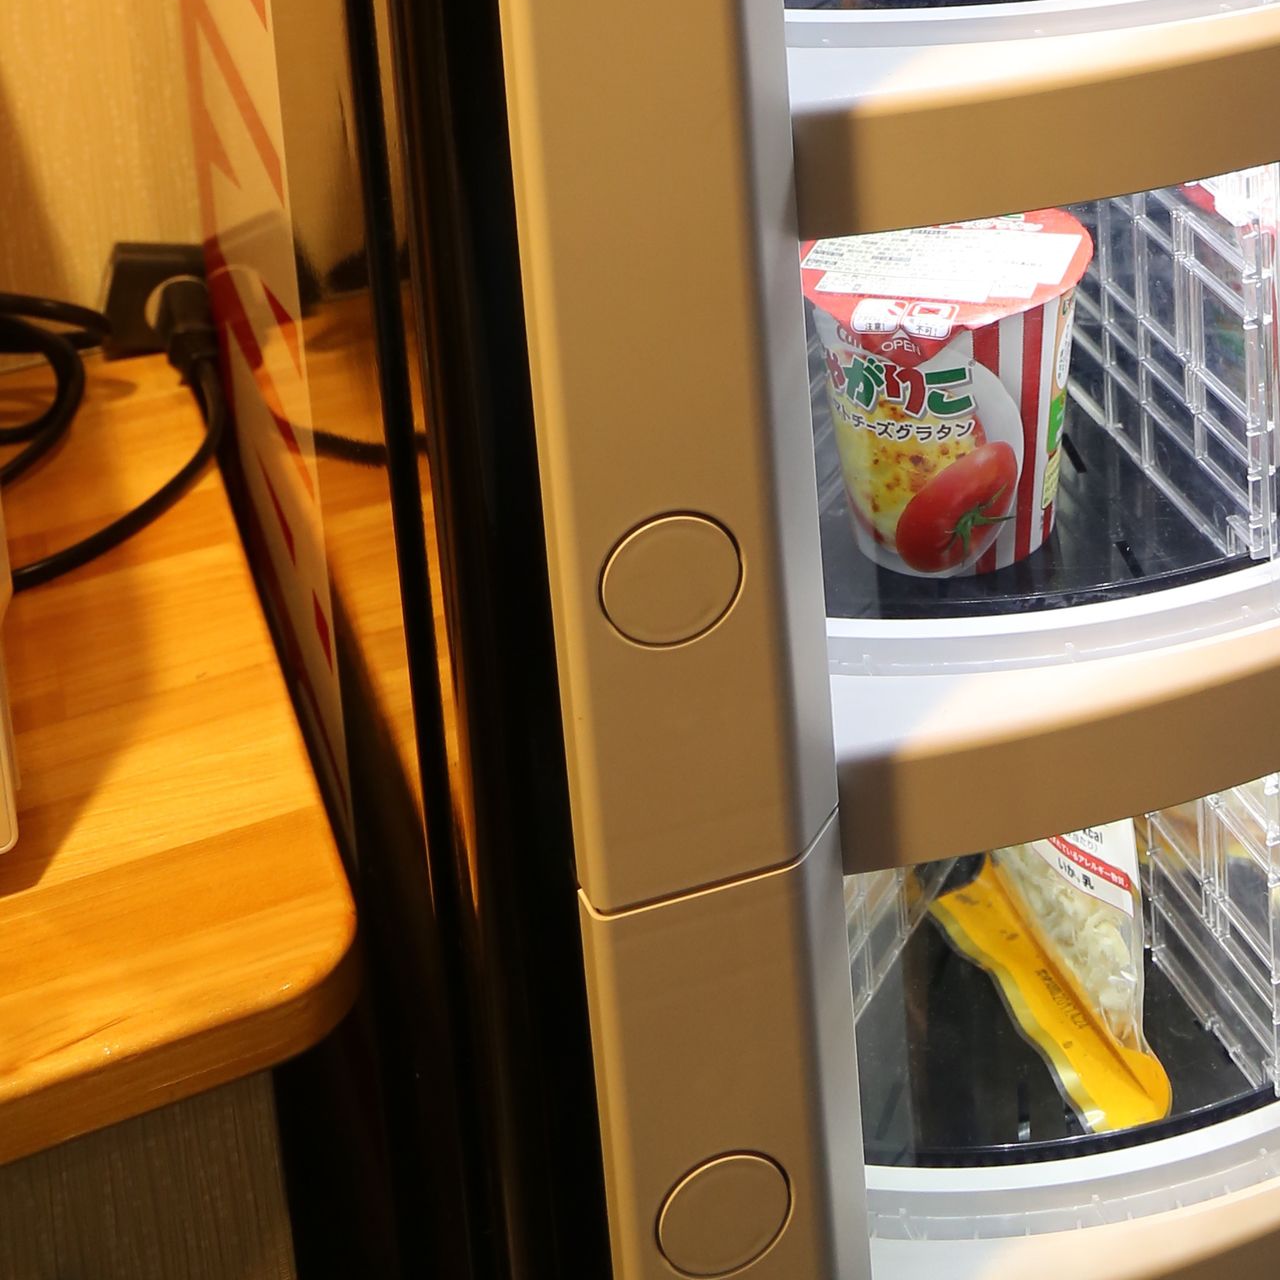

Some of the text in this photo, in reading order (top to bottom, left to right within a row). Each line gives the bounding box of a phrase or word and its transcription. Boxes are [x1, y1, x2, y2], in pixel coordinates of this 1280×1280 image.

[881, 340, 922, 356] OPEN
[1057, 857, 1095, 891] いか、乳
